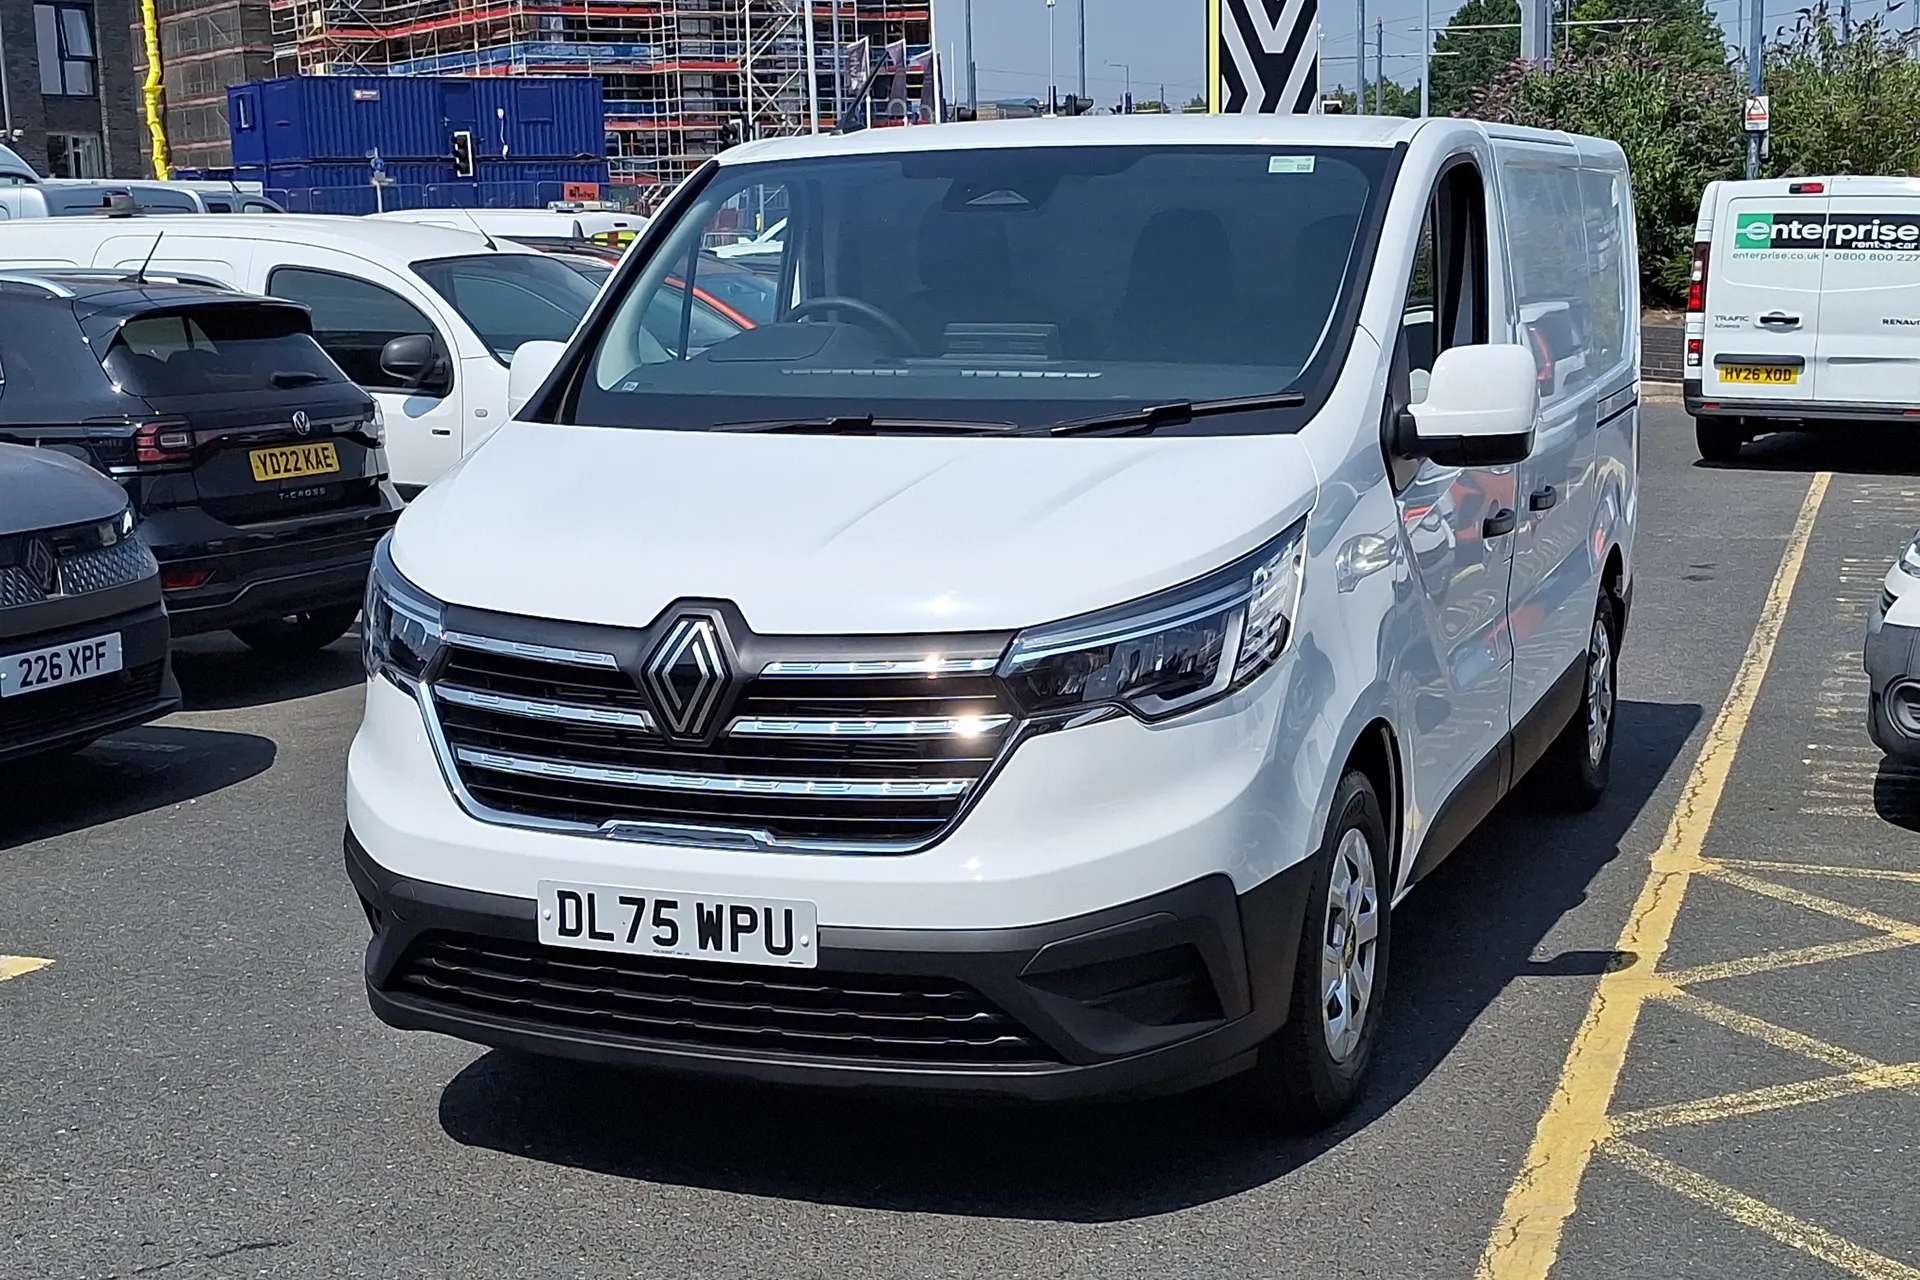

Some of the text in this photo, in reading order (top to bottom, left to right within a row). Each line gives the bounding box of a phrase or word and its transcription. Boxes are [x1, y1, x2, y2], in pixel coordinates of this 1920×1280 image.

[1737, 219, 1920, 245] enterprise
[1851, 240, 1918, 249] rent-a-car
[1732, 252, 1820, 261] enterprise.co.uk
[1833, 252, 1866, 262] 0800
[1869, 253, 1894, 262] 800
[1713, 314, 1750, 322] TRAFIC
[1724, 366, 1792, 382] HV26 XOD
[257, 446, 333, 476] YD22 KAE
[279, 486, 327, 501] T-CROSS
[18, 641, 107, 688] 226 XPF
[557, 889, 794, 956] DL75 WPU
